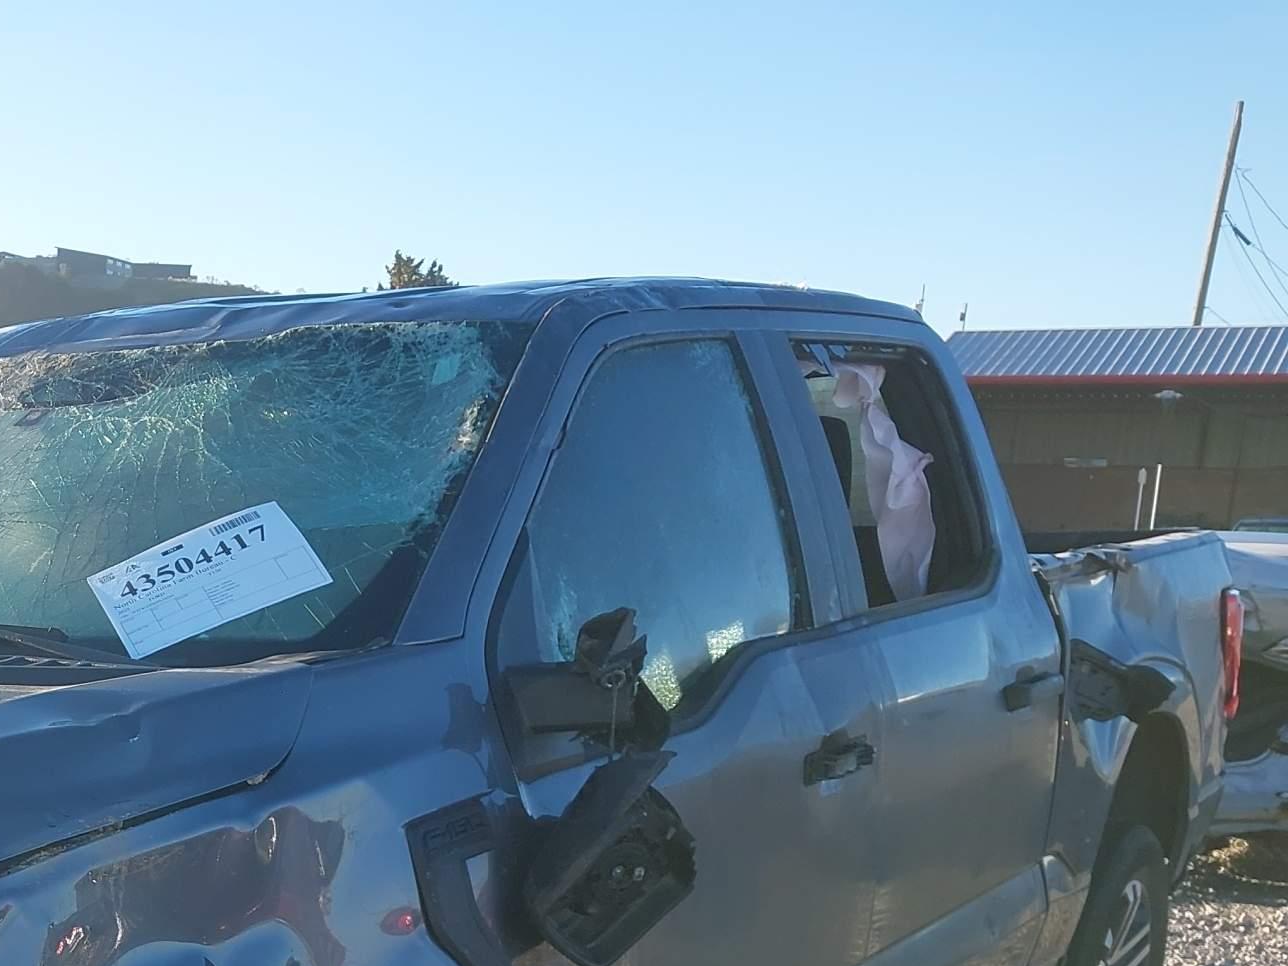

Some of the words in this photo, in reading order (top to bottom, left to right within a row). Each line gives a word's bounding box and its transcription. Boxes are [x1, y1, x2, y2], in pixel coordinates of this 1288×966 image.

[121, 524, 265, 597] 43504417
[113, 598, 137, 609] North
[138, 583, 172, 600] Carolina
